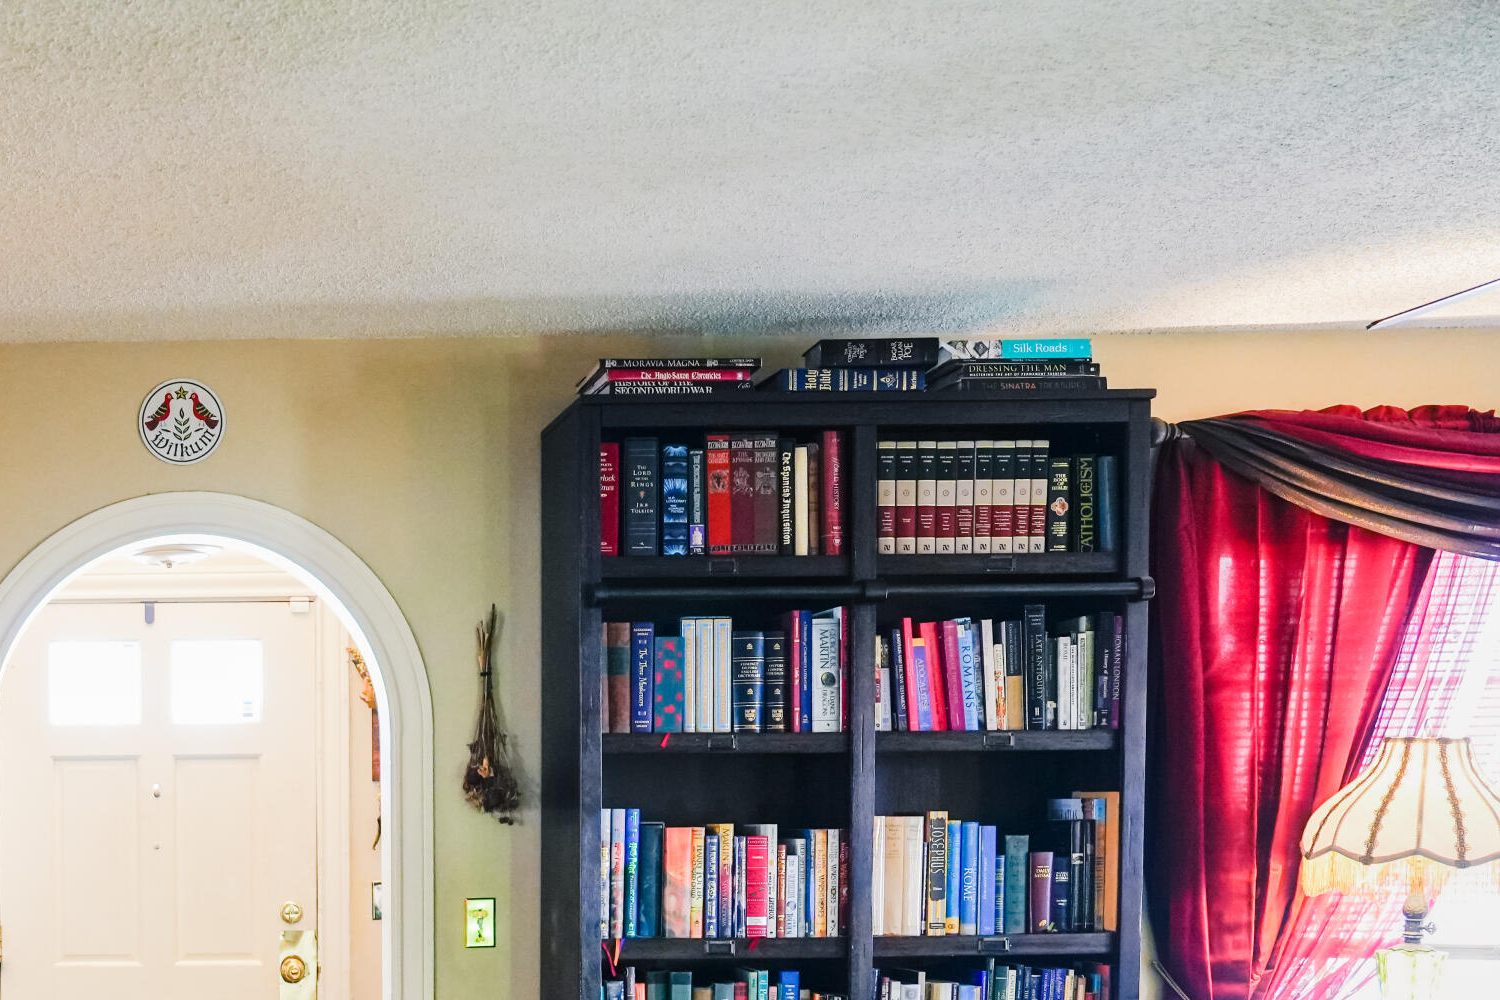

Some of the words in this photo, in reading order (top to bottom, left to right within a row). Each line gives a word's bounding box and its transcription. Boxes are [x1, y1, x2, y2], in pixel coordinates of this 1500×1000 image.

[904, 342, 913, 358] POE
[1013, 343, 1032, 353] Silk
[1035, 343, 1067, 353] Roads
[623, 359, 664, 367] MORAVIA
[668, 359, 701, 367] MAGNA
[640, 372, 652, 380] The
[655, 371, 689, 380] Anglo-Saxon
[691, 371, 722, 380] Chronicles
[968, 364, 1017, 373] DRESSING
[1021, 364, 1041, 372] THE
[1044, 364, 1067, 372] MAN
[615, 387, 655, 395] SECOND
[655, 387, 690, 395] WORLD
[805, 369, 819, 390] Holy
[819, 369, 832, 391] Bible
[151, 429, 215, 457] Wilkum
[782, 452, 791, 464] The
[781, 465, 791, 498] Spanish
[1080, 457, 1093, 552] CATHOLICISM
[781, 498, 791, 545] Inquisition
[639, 648, 648, 659] The
[819, 628, 830, 669] MARTIN
[1035, 634, 1043, 652] LATE
[1114, 634, 1122, 664] ROMAN
[917, 657, 929, 711] APOCALYPSE
[962, 646, 975, 708] ROMANS
[1035, 655, 1043, 701] ANTIQUITY
[1113, 665, 1121, 700] LONDON
[722, 828, 730, 860] MARTIN
[931, 825, 945, 874] JOSEPHUS
[963, 867, 973, 901] ROME
